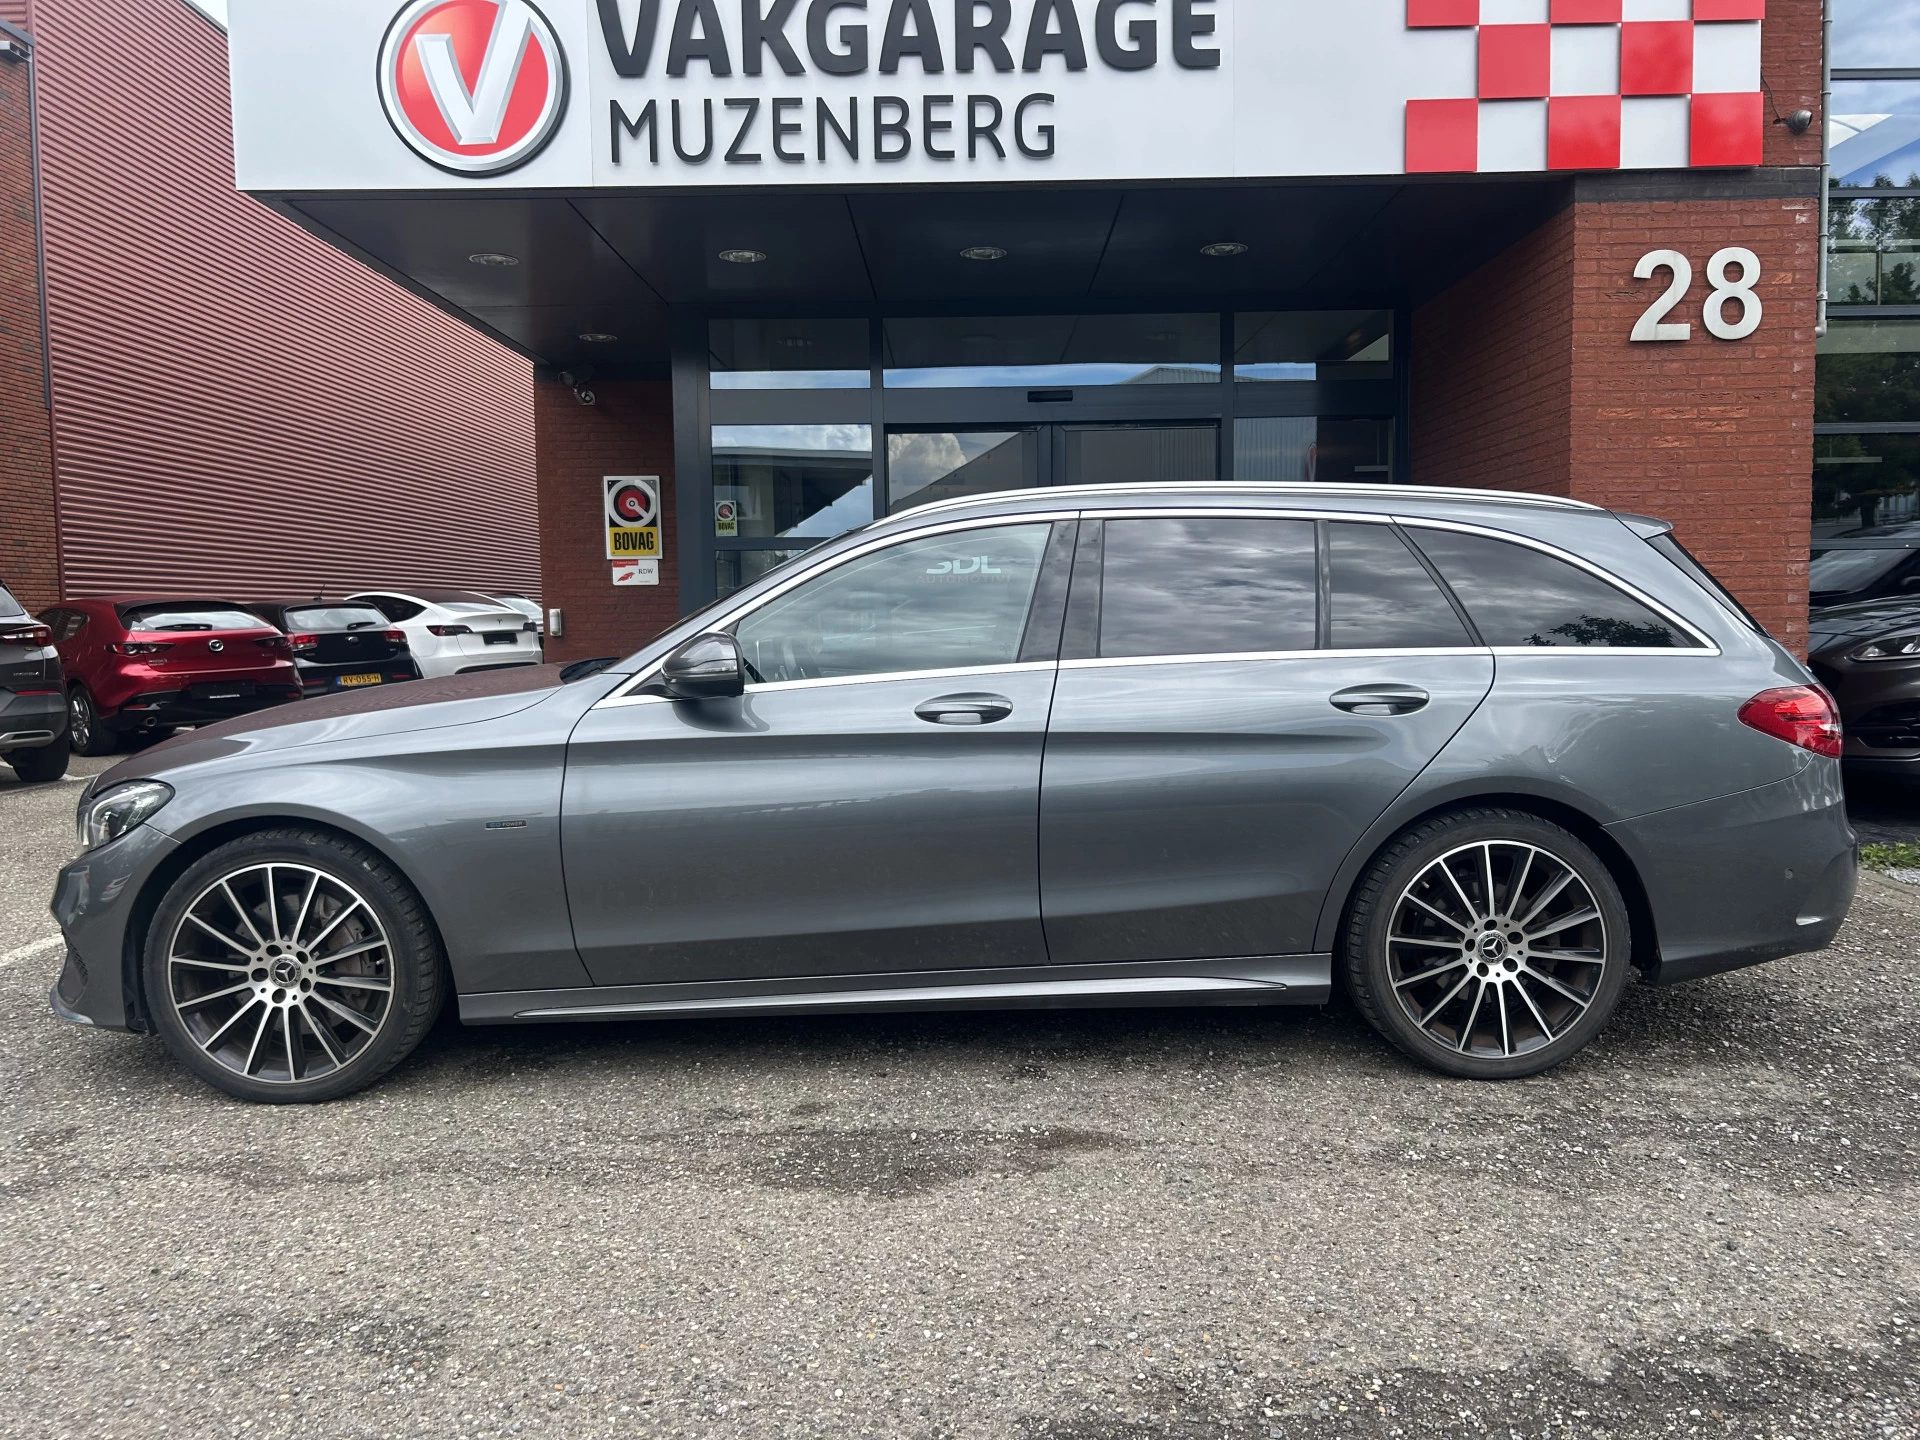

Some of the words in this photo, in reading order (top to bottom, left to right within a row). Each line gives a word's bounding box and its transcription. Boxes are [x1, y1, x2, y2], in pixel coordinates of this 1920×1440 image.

[597, 0, 1221, 76] VAKGARAGE
[609, 93, 1056, 163] MUZENBERG
[1629, 246, 1763, 342] 28
[613, 532, 654, 550] BOVAG
